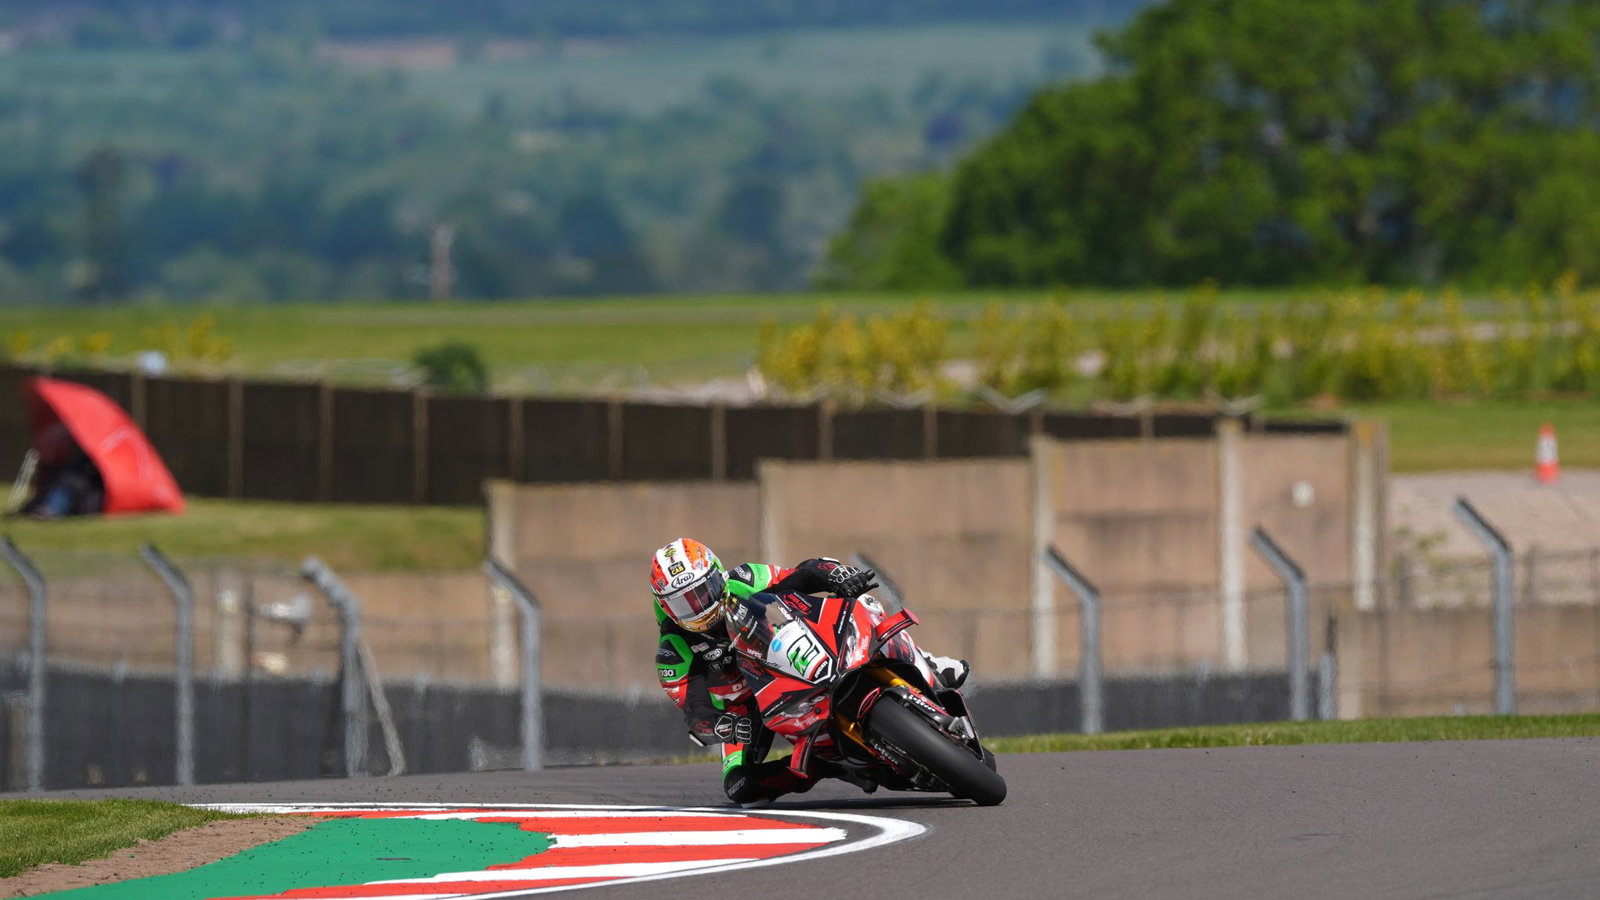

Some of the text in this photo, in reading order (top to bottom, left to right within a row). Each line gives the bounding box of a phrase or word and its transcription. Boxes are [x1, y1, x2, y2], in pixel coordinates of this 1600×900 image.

[671, 566, 684, 575] CAB
[675, 574, 692, 585] Arai
[786, 634, 820, 677] 2
